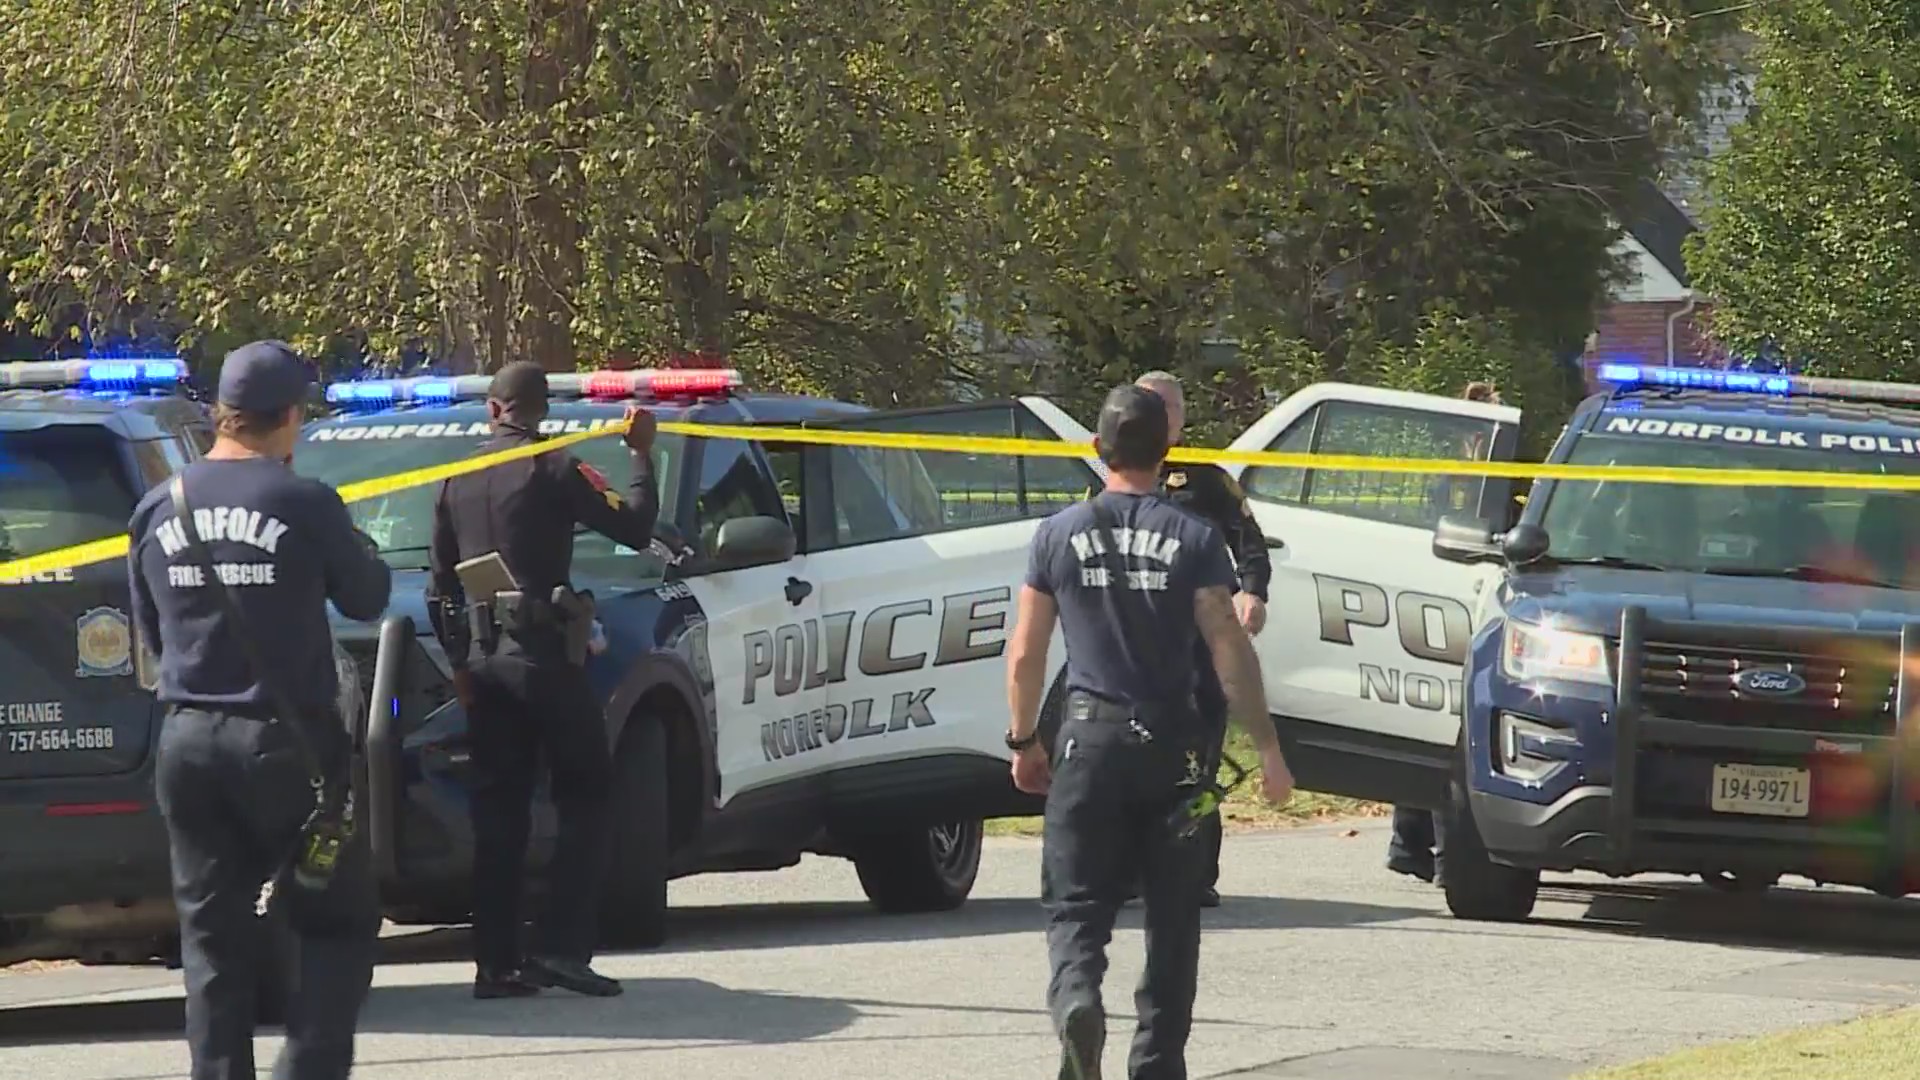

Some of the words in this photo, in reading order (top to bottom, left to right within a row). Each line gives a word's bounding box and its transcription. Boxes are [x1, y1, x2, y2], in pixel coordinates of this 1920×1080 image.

[1606, 417, 1808, 447] NORFOLK
[1820, 433, 1920, 454] POLI
[168, 564, 206, 588] FIRE
[742, 586, 1011, 705] POLICE
[1750, 671, 1788, 690] Ford
[8, 702, 62, 724] CHANGE
[760, 687, 936, 762] NORFOLK
[8, 727, 114, 752] 757-664-6688
